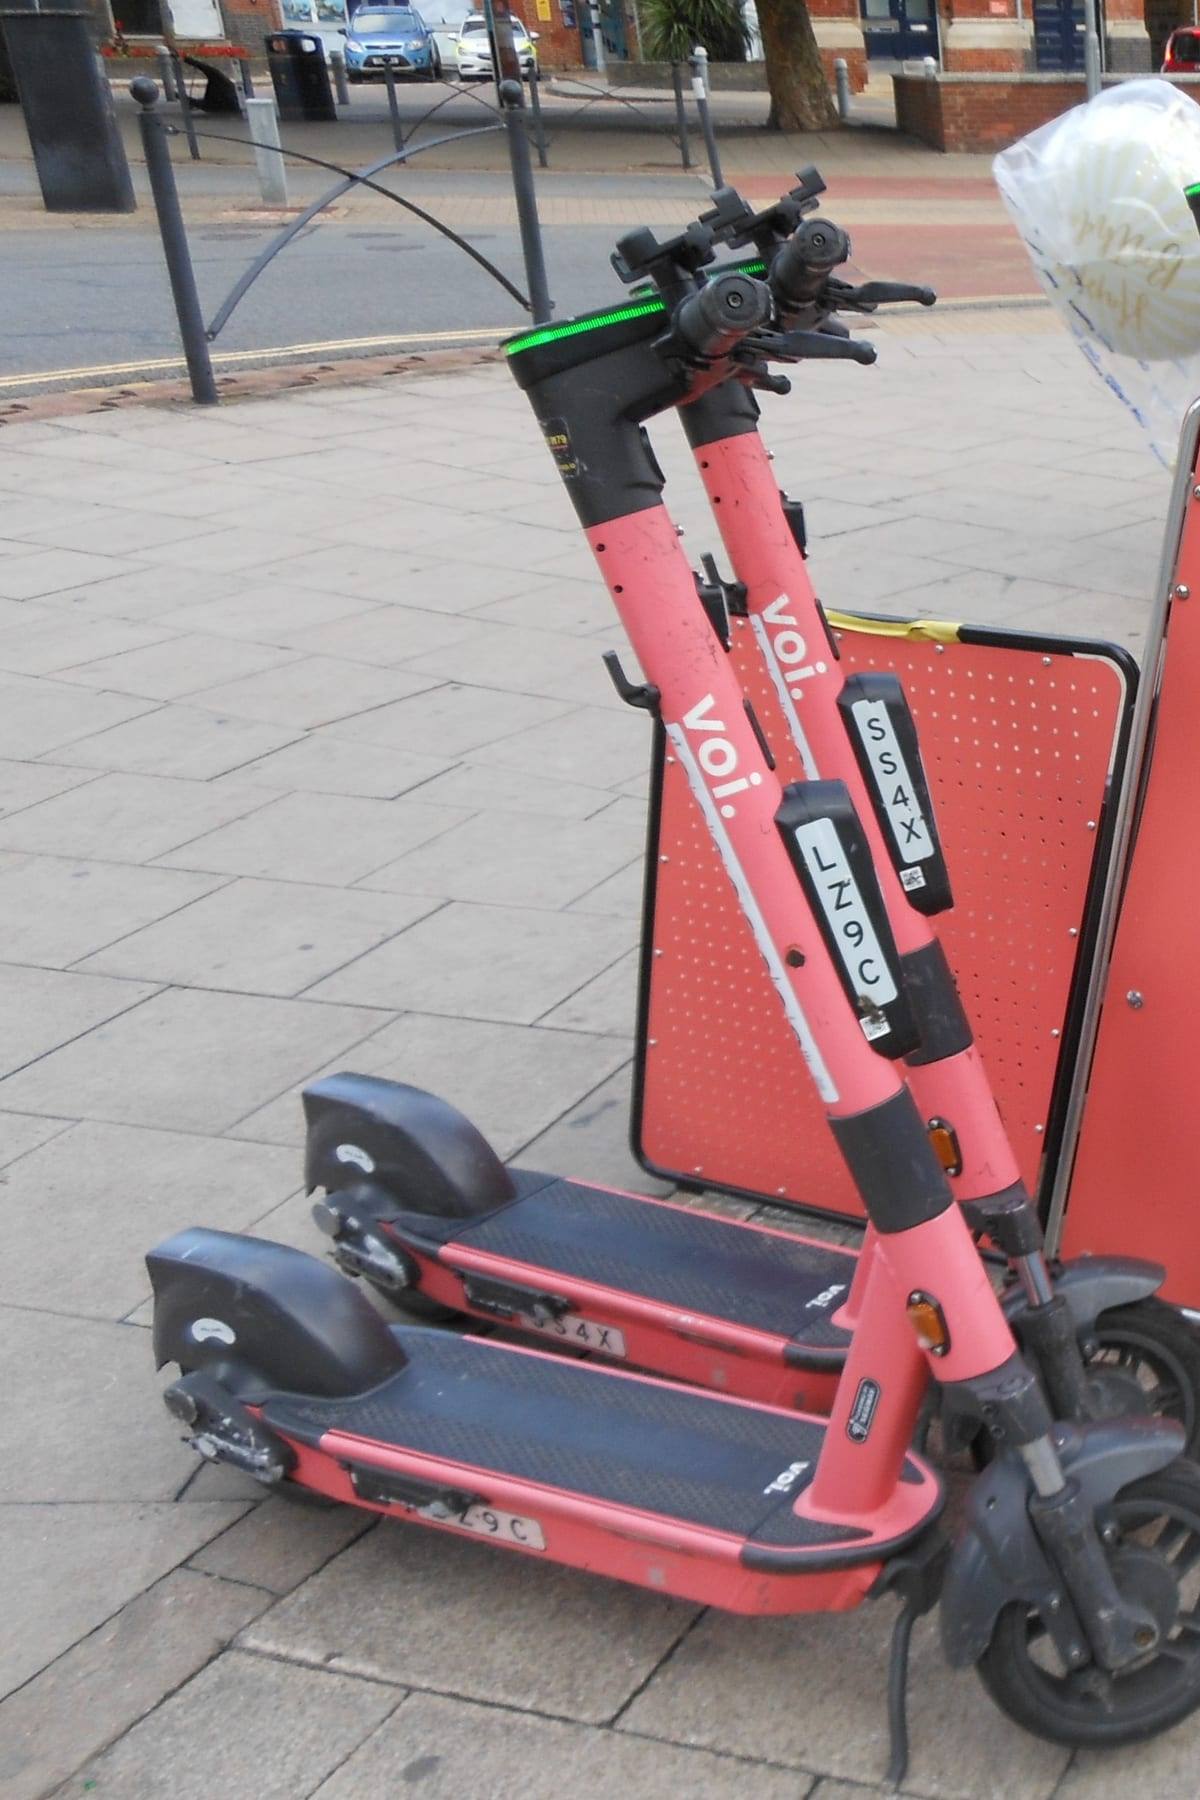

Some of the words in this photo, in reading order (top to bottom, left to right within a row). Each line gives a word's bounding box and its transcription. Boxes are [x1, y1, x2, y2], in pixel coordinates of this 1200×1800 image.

[761, 592, 828, 701] voi.
[682, 692, 763, 820] voi.
[866, 717, 922, 844] SS4X
[811, 845, 881, 986] LZ9C
